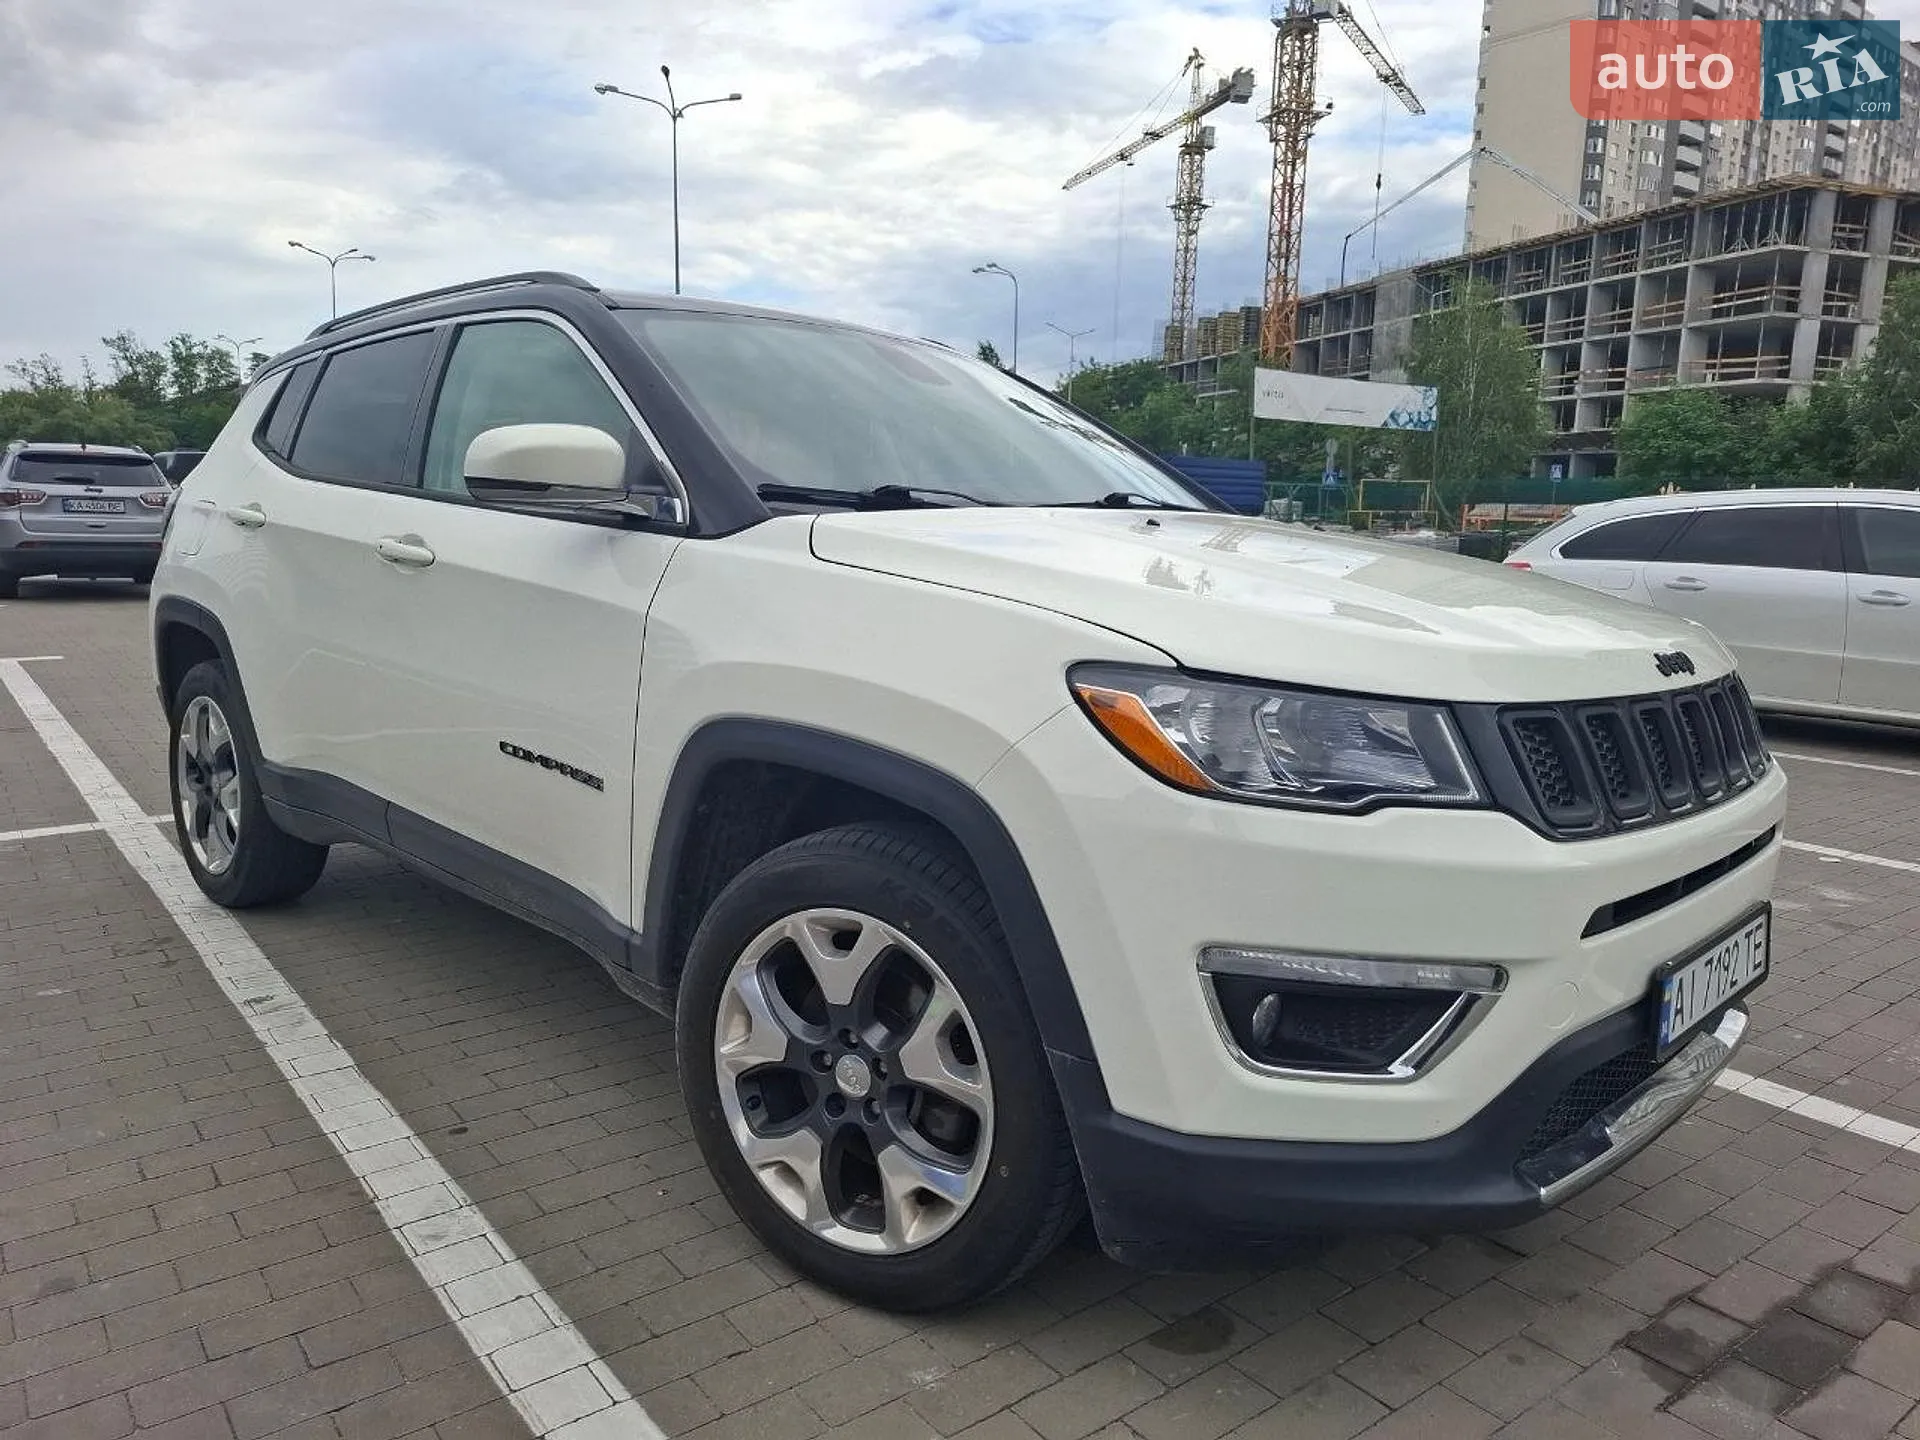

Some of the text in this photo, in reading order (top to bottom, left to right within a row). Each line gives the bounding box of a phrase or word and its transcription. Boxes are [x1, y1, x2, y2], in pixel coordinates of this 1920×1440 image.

[499, 740, 605, 792] COMPASS
[1672, 922, 1764, 1033] AI 7192 TE
